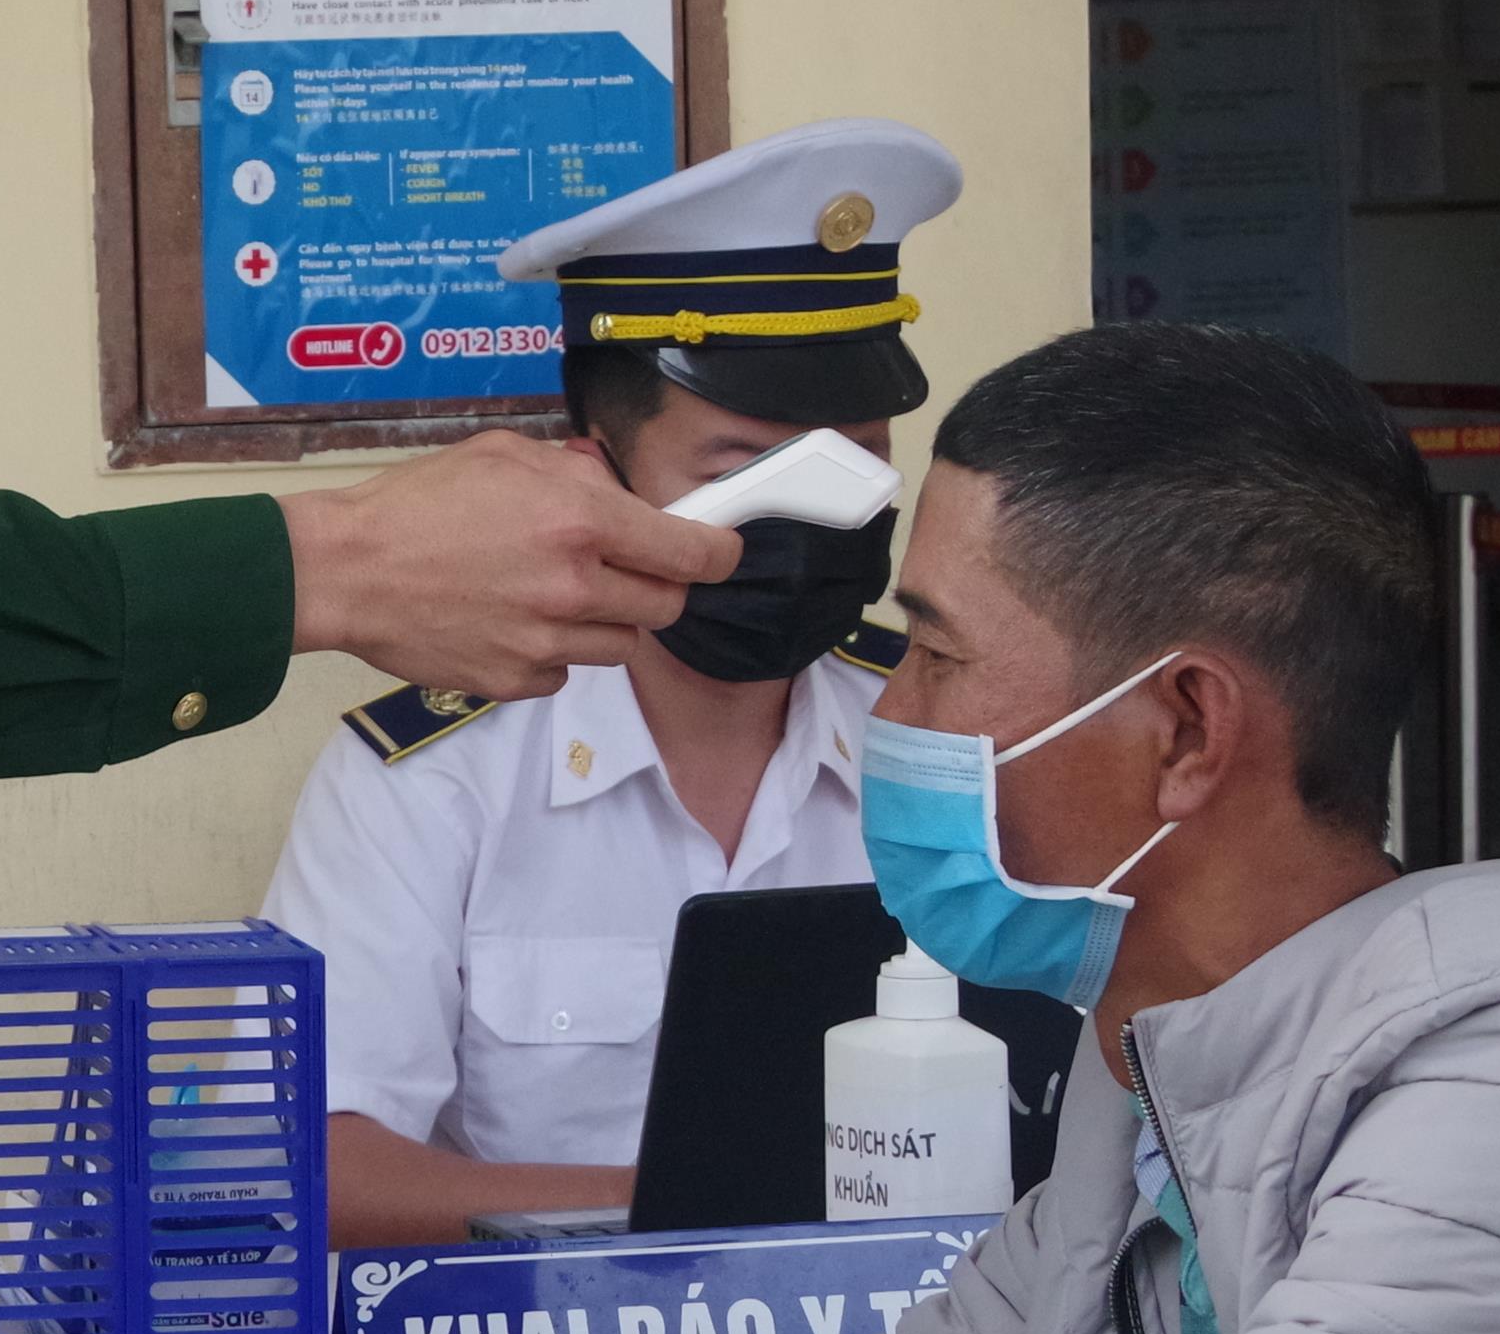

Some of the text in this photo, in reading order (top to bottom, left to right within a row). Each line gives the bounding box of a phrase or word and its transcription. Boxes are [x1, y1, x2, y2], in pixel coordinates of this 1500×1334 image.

[292, 1, 318, 10] Have
[322, 0, 349, 9] close
[306, 339, 353, 355] HOTLINE
[425, 328, 493, 353] 0912
[499, 329, 547, 351] 330
[825, 1123, 936, 1159] NG DỊCH SÁT
[835, 1172, 889, 1208] KHUẨN
[166, 1255, 203, 1266] TRANG
[207, 1254, 214, 1266] Y
[217, 1250, 229, 1265] TẾ
